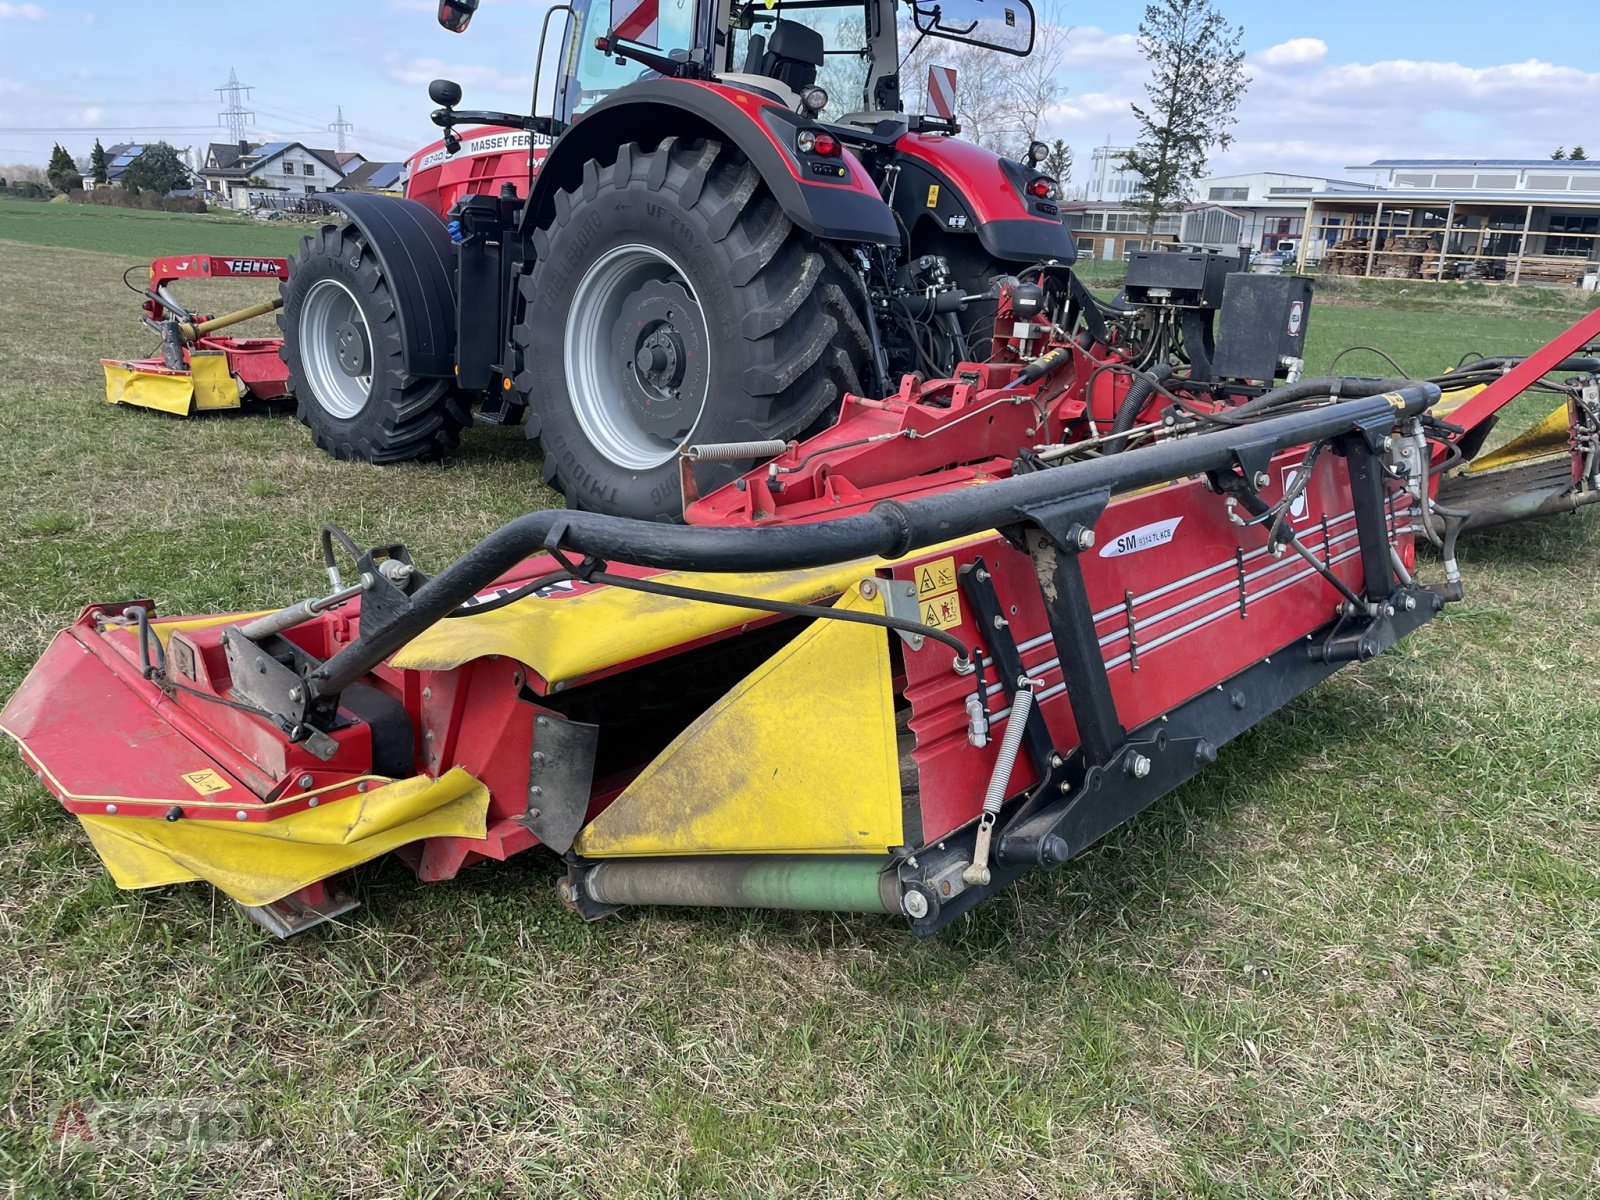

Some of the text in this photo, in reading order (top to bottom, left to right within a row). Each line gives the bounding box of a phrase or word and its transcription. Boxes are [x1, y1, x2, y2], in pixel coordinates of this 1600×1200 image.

[471, 136, 510, 153] MASSEY
[424, 152, 443, 166] 8740
[231, 260, 277, 274] FELLA
[1117, 535, 1137, 553] SM
